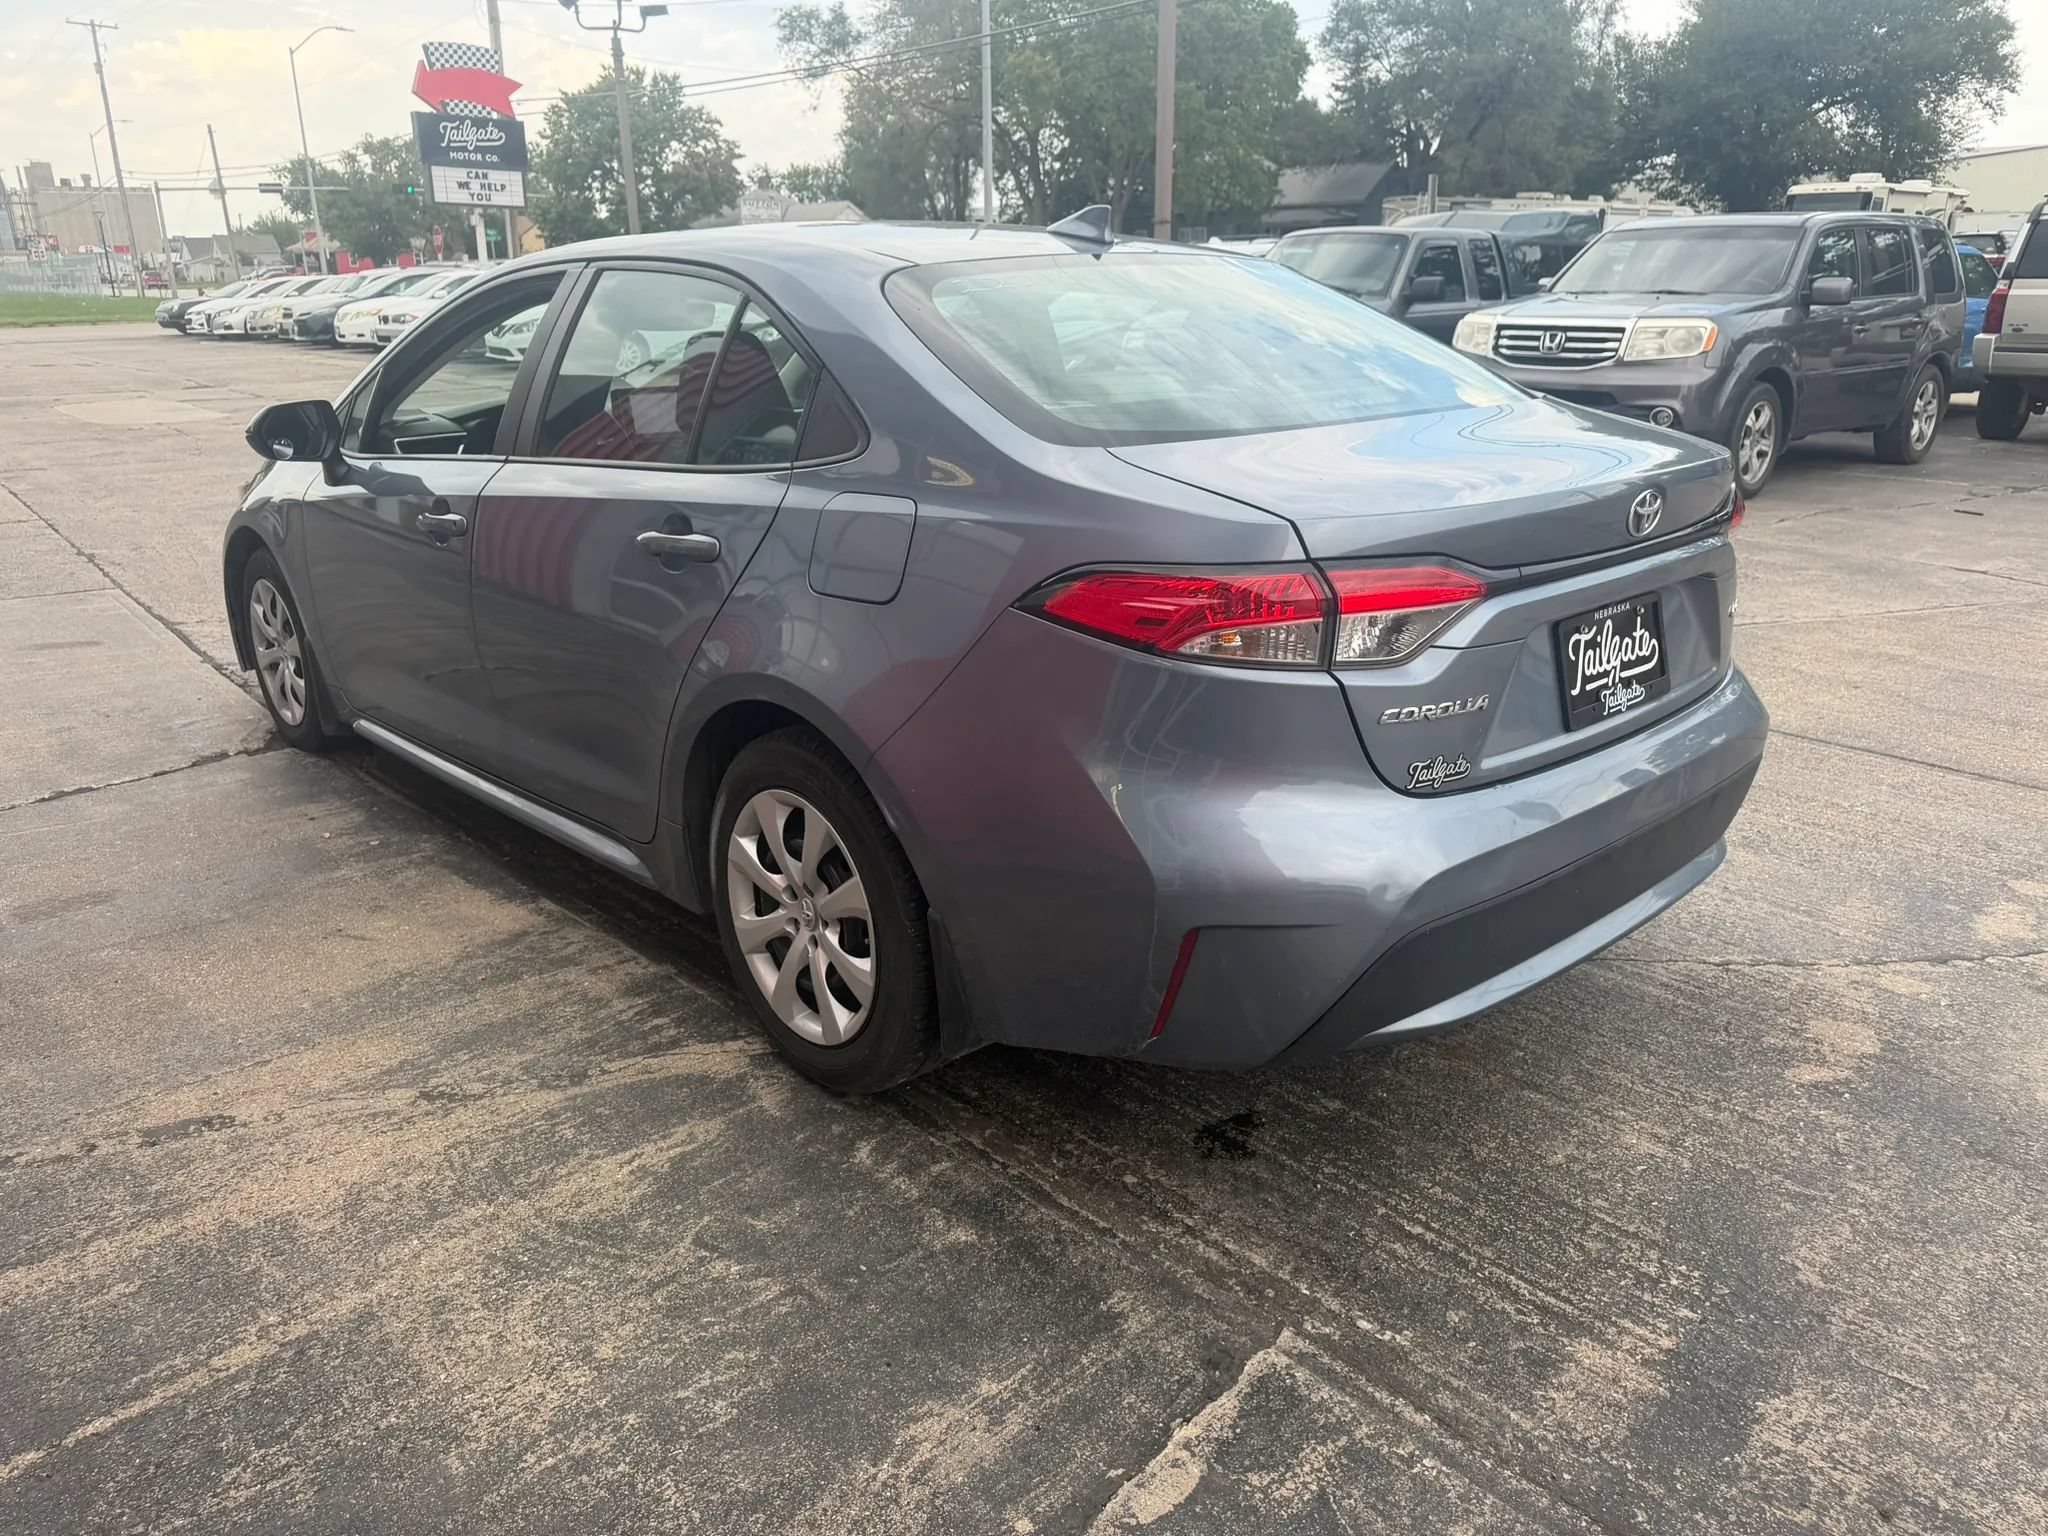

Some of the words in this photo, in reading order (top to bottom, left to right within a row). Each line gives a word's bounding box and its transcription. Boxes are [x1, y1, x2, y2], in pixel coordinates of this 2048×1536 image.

[440, 119, 505, 150] Tailgate
[450, 151, 482, 162] MOTOR
[456, 181, 472, 191] WE
[480, 183, 507, 192] HELP
[466, 170, 489, 180] CAN
[468, 191, 492, 202] YOU
[1594, 601, 1631, 620] NEBRASKA
[1568, 616, 1659, 696] Tailgate
[1378, 694, 1489, 725] COROLLA
[1601, 679, 1645, 716] Tailgate
[1406, 753, 1471, 788] Tailgate
